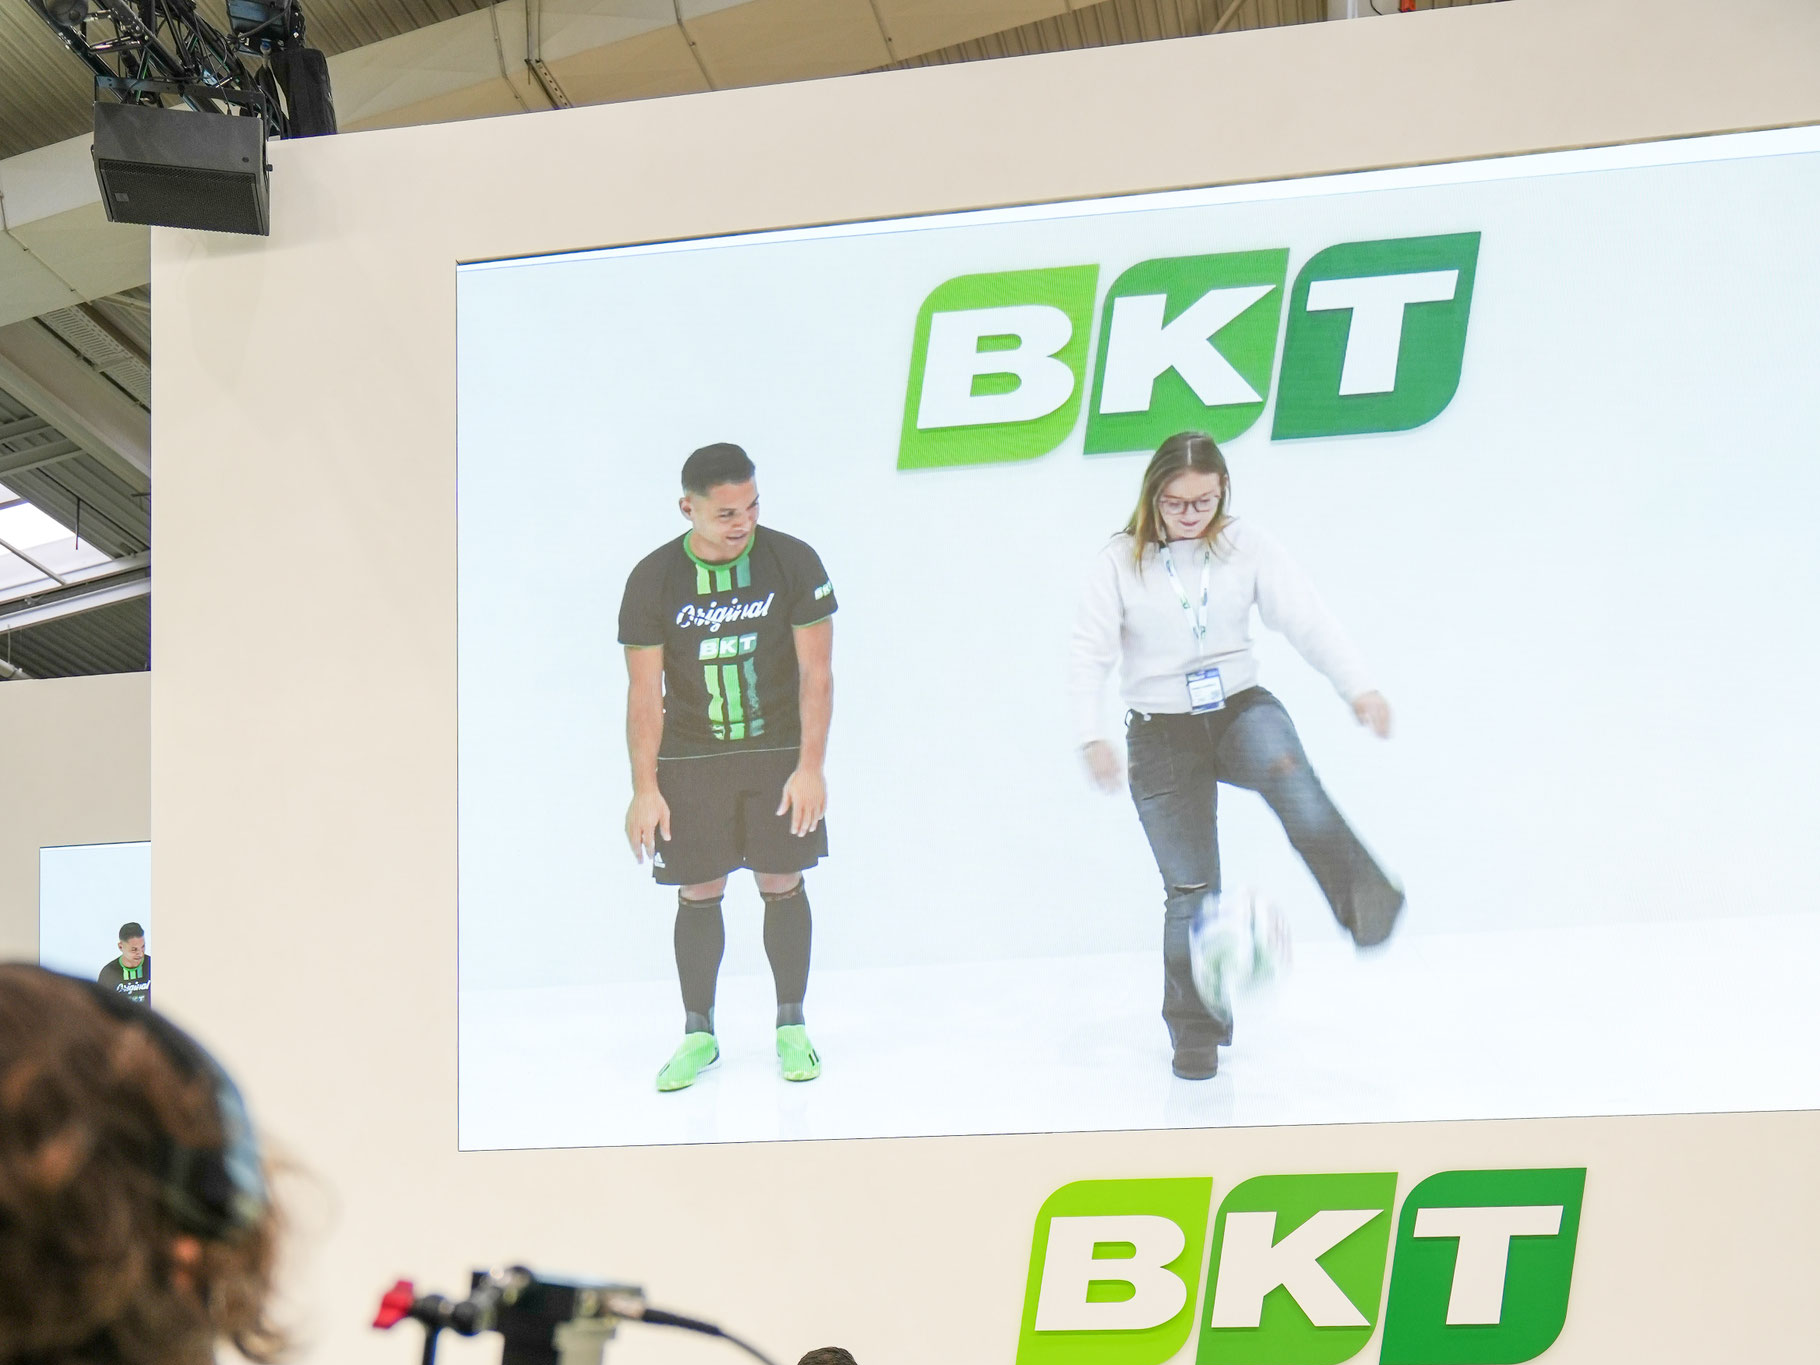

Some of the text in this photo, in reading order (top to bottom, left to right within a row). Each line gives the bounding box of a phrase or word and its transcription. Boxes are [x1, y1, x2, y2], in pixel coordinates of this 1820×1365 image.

[917, 269, 1459, 430] BKT
[676, 592, 775, 632] Original
[701, 635, 757, 659] BKT
[1034, 1205, 1564, 1331] BKT
